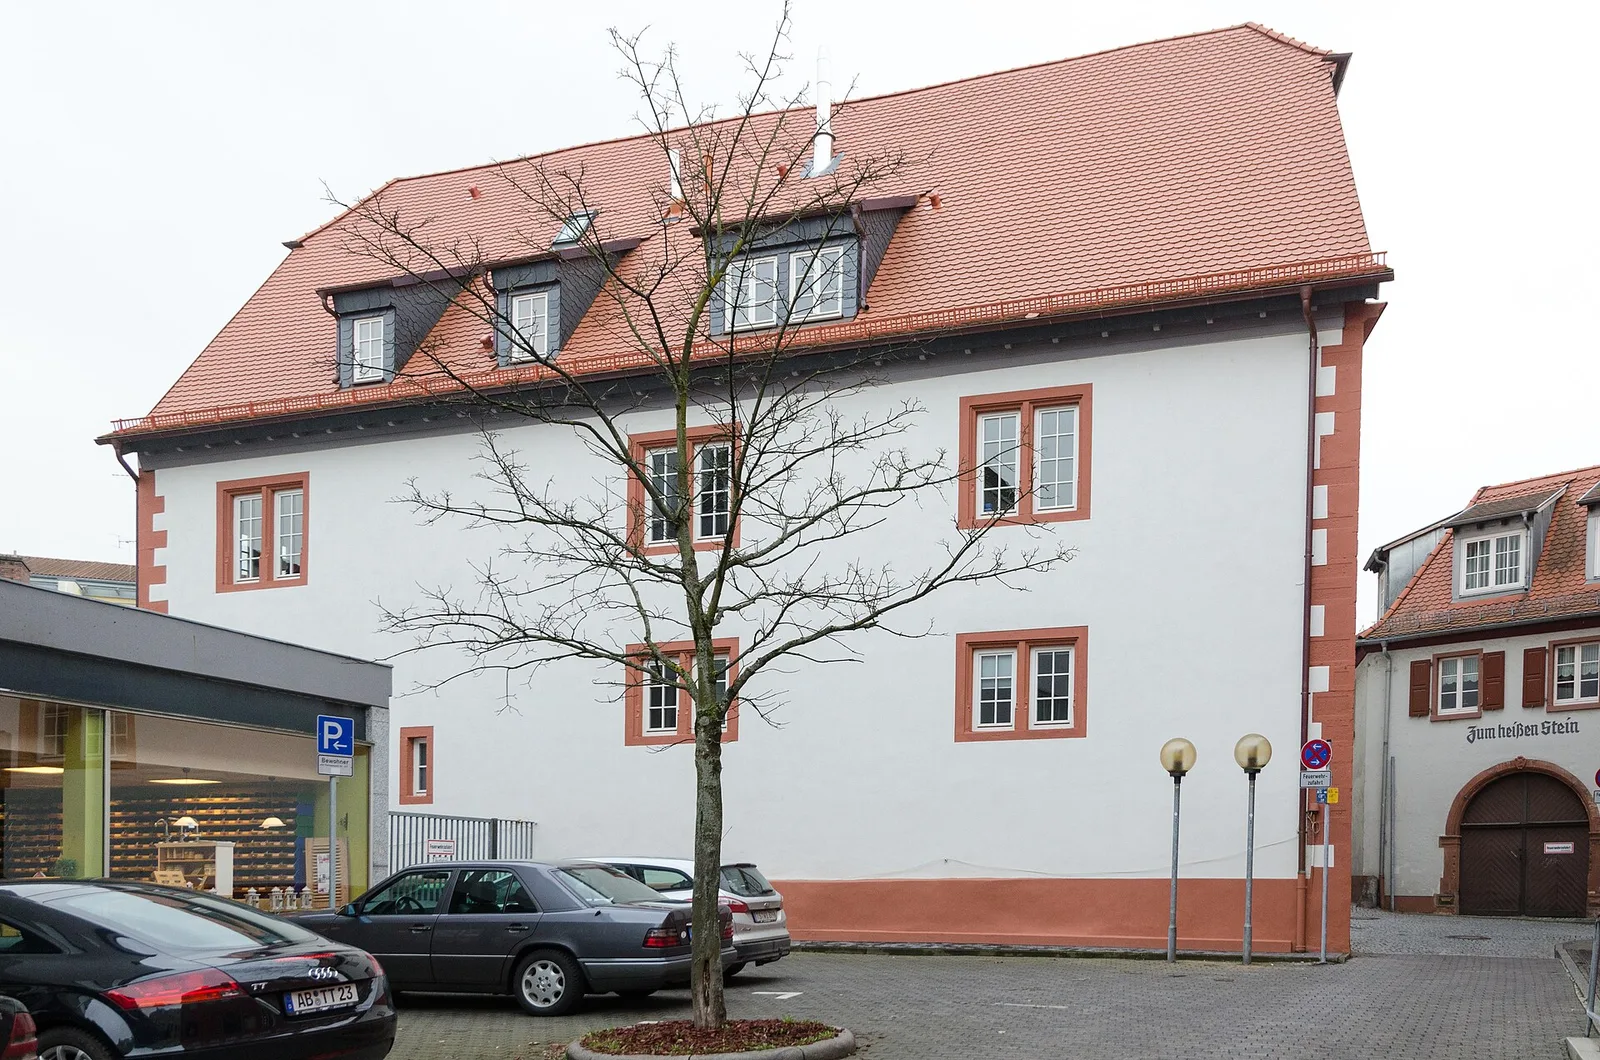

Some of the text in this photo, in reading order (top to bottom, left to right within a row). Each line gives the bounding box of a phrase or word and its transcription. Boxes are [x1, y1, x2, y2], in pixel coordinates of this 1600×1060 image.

[323, 720, 343, 749] P
[1466, 717, 1580, 744] Zum heißen Stein
[321, 757, 349, 765] Bewohner
[251, 982, 268, 991] TT
[297, 985, 353, 1008] AB TT 23
